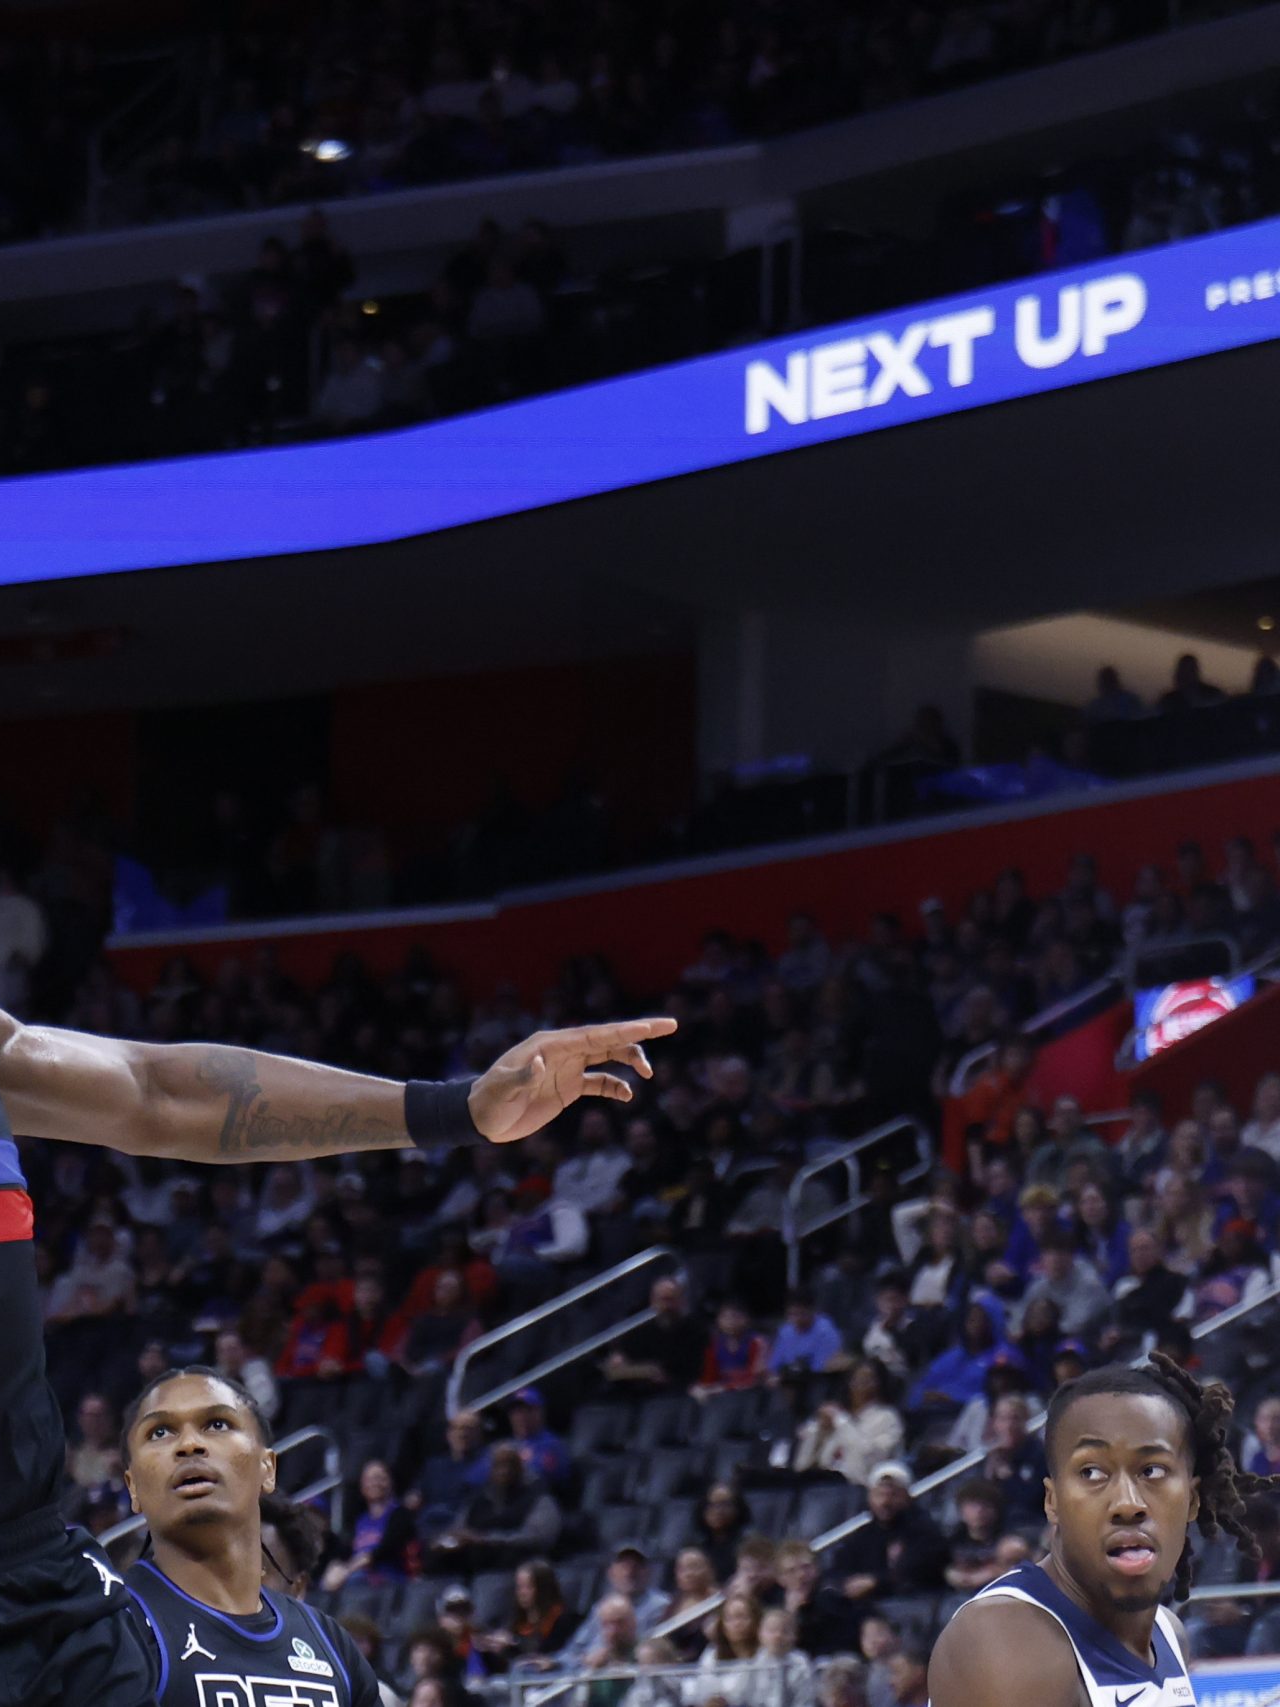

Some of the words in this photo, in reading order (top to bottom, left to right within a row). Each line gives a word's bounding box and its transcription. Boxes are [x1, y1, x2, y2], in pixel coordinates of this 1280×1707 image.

[745, 305, 995, 435] NEXT
[1014, 272, 1148, 369] UP
[1205, 268, 1280, 312] PRE
